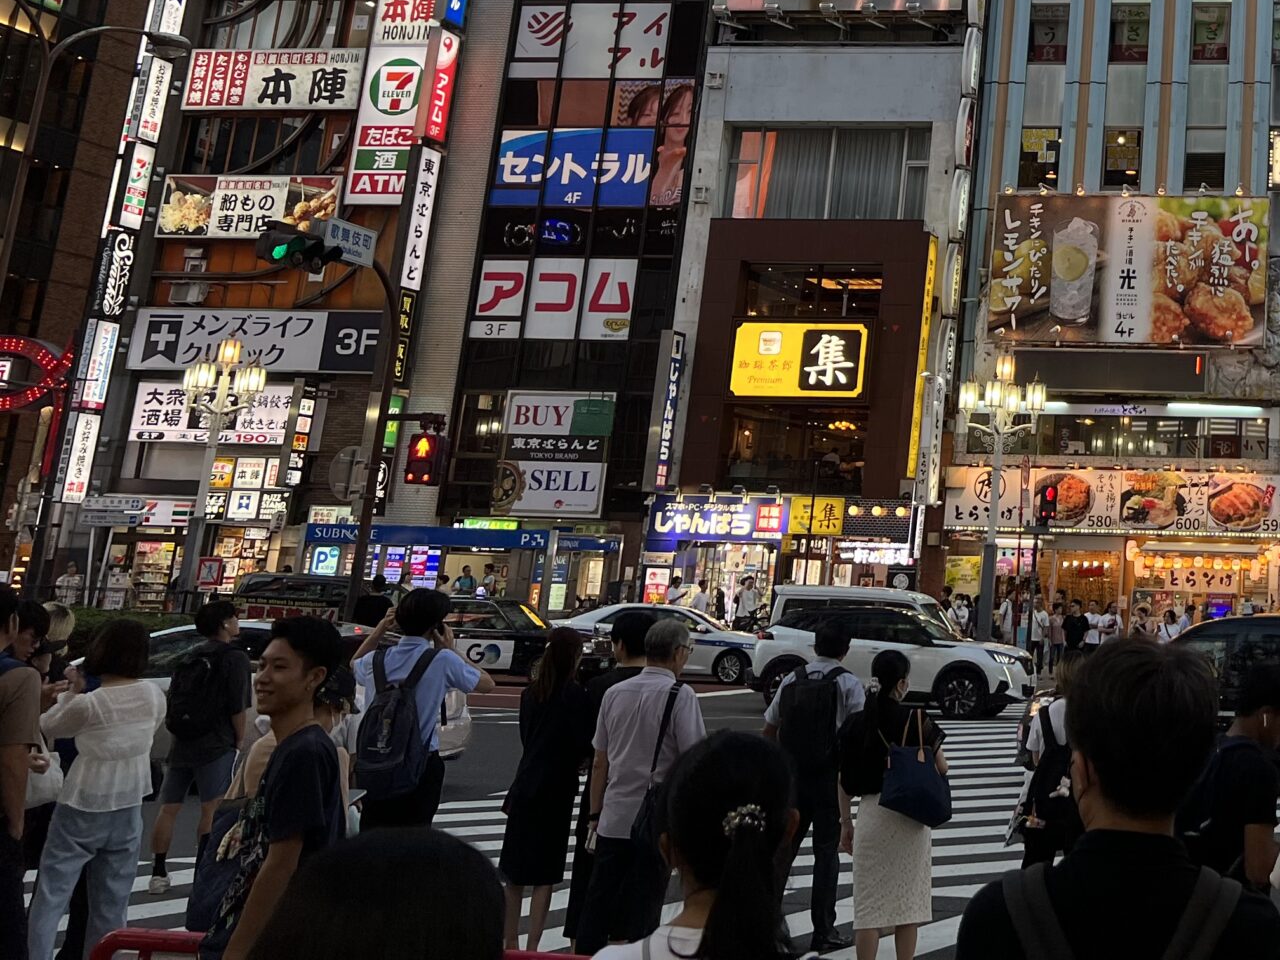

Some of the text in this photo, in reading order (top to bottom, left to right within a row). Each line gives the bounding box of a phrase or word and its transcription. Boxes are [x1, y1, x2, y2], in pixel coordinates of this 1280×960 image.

[382, 25, 430, 40] HONJIN
[209, 54, 229, 103] たこ焼き
[257, 67, 349, 106] 本陣
[432, 73, 449, 123] アコム
[366, 127, 413, 145] たばこ
[373, 151, 398, 169] 酒
[500, 152, 650, 185] セントラル
[355, 175, 406, 192] ATM
[220, 193, 275, 211] 粉もの
[564, 192, 582, 204] 4F
[216, 215, 273, 232] 専門店
[330, 223, 373, 250] 歌舞伎町
[1002, 209, 1023, 330] レモンサワー
[1119, 268, 1137, 290] 光
[479, 272, 630, 313] アコム
[187, 315, 313, 338] メンズライフ
[485, 324, 507, 335] 3F
[1114, 321, 1135, 338] 4F
[336, 329, 379, 354] 3F
[804, 333, 854, 386] 集
[747, 375, 783, 384] Premium
[144, 388, 187, 406] 大衆
[141, 409, 182, 426] 酒場
[513, 404, 570, 426] BUY
[235, 434, 279, 444] 190円
[554, 452, 579, 460] BRAND
[528, 469, 597, 492] SELL
[1096, 474, 1104, 493] そば
[1106, 473, 1117, 512] かき揚げ
[817, 503, 840, 530] 集
[1088, 515, 1118, 528] 580円
[1175, 518, 1207, 531] 600円
[315, 551, 328, 568] P
